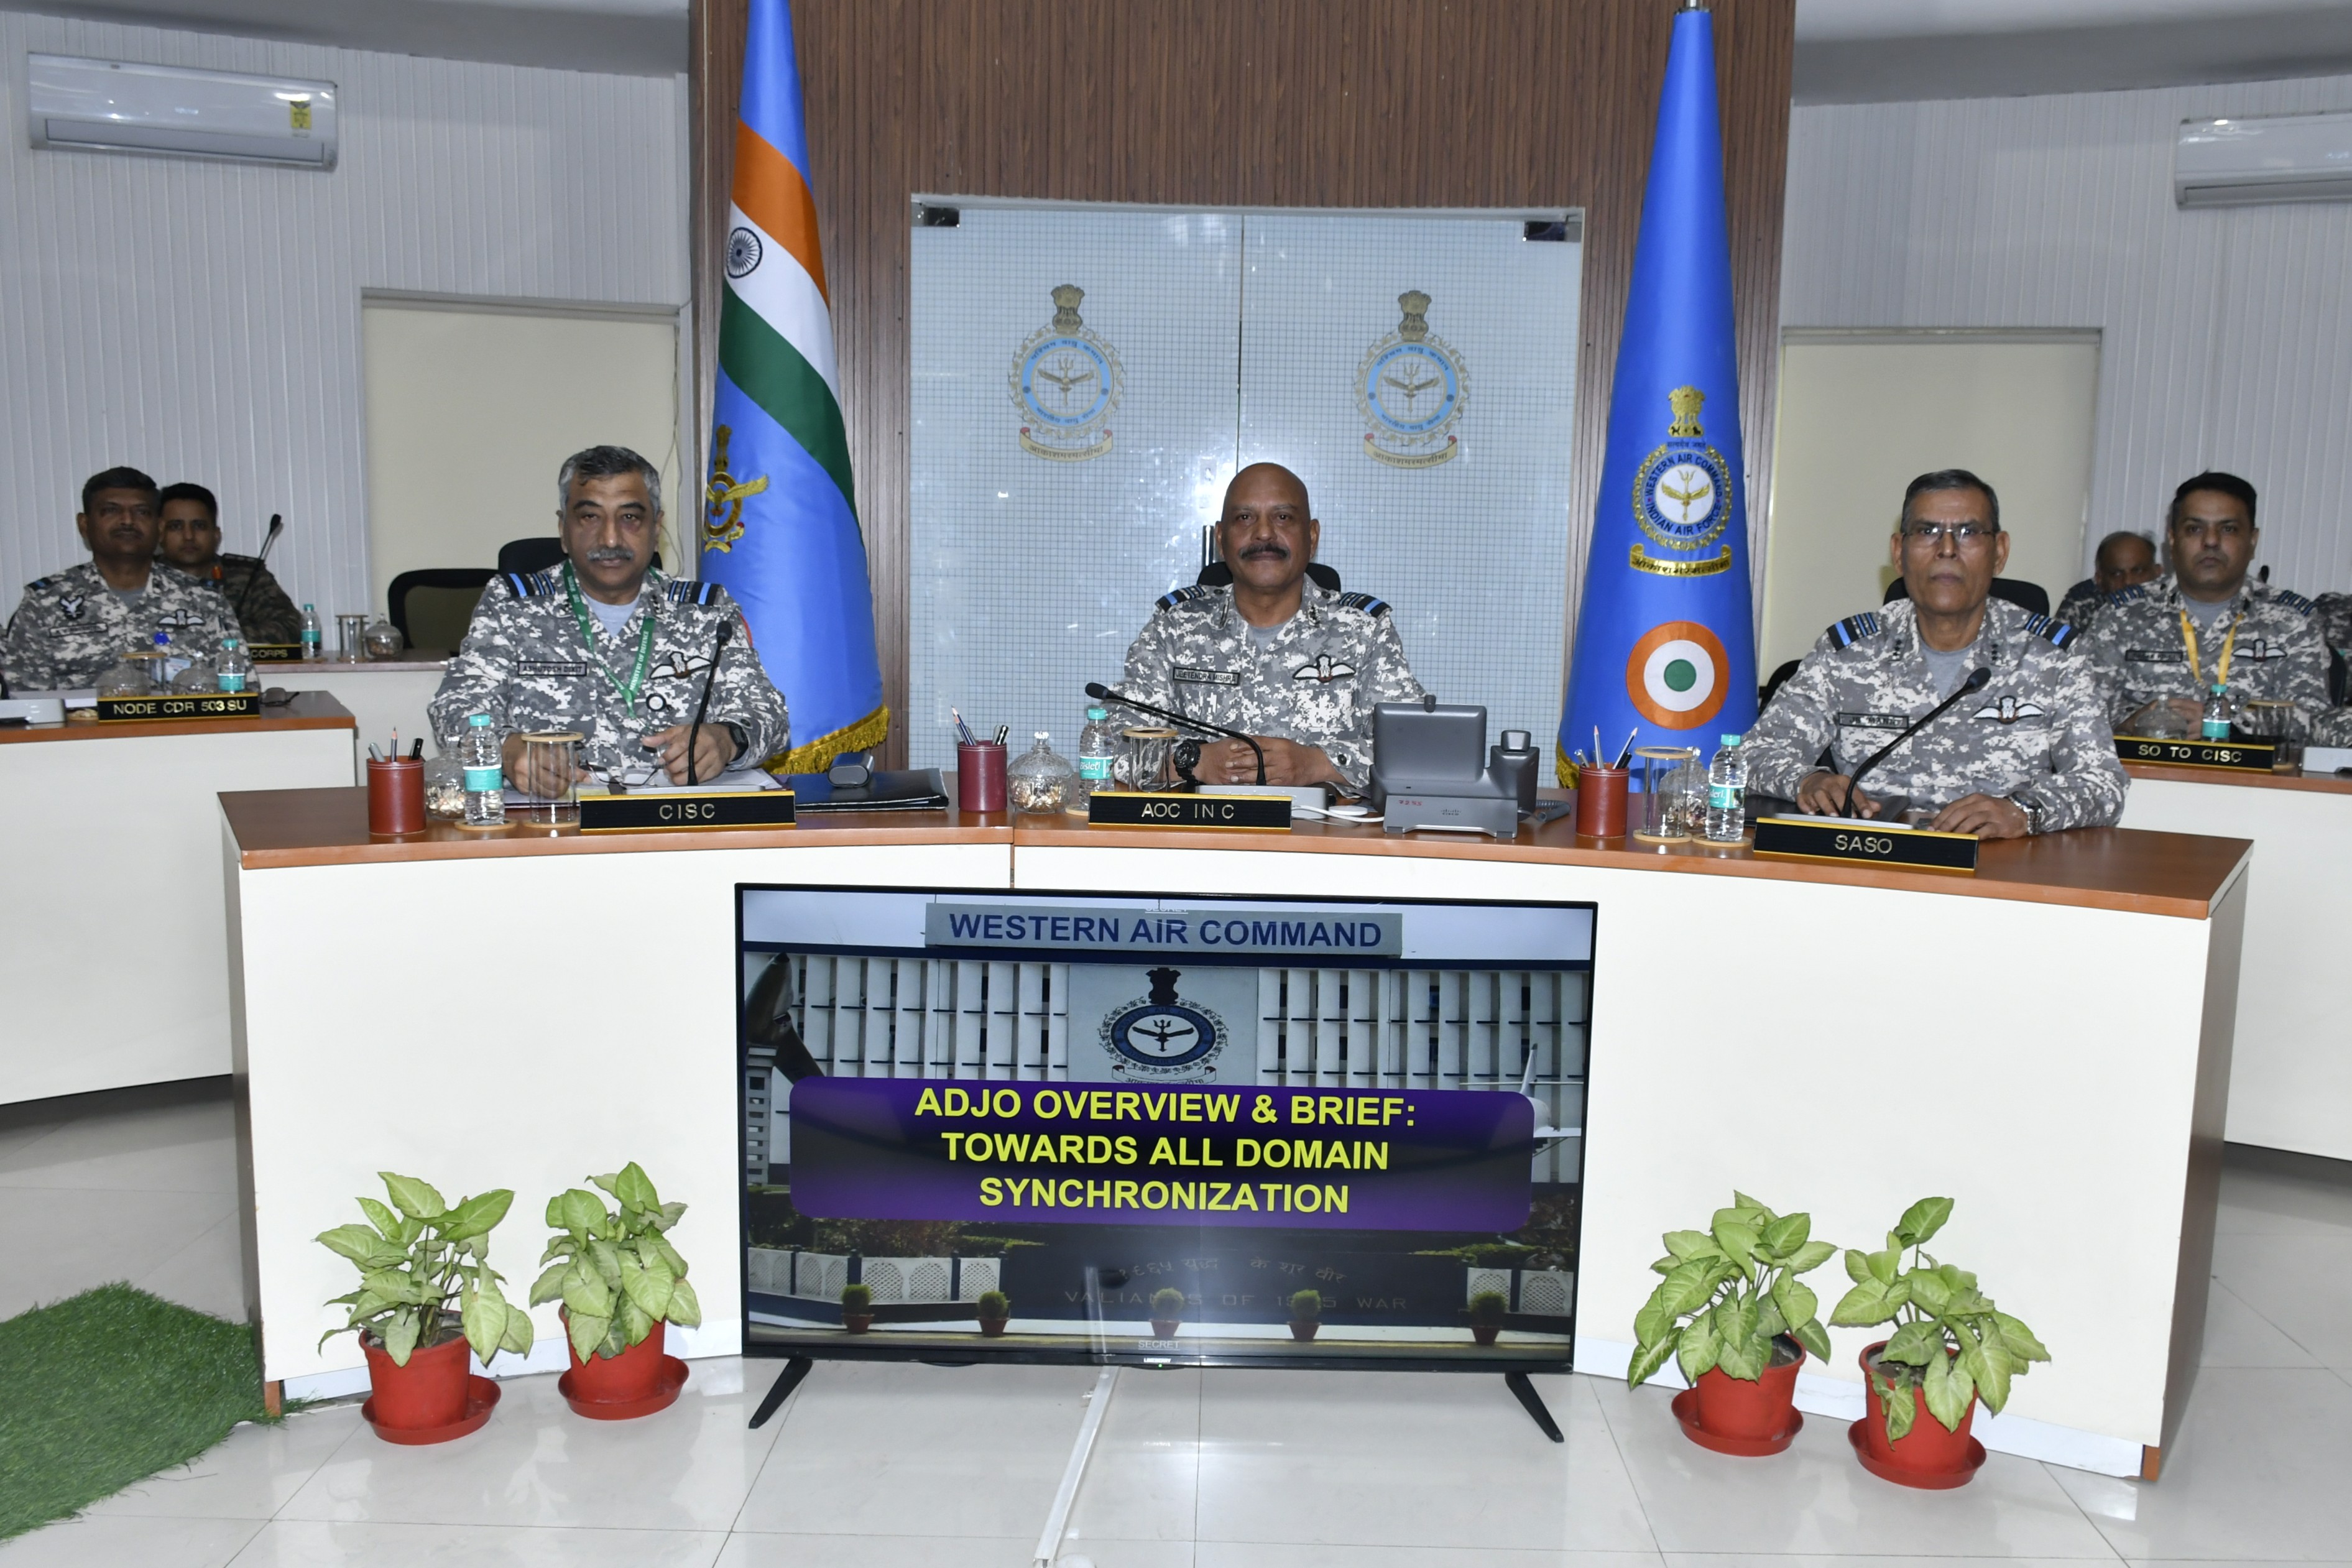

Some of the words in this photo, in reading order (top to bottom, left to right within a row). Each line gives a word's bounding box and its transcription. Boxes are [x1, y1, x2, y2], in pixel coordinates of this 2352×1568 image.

[1645, 456, 1675, 496] WESTERN
[1677, 454, 1692, 463] AIR
[1695, 456, 1723, 497] COMMAND
[1646, 503, 1673, 532] INDIAN
[1674, 526, 1694, 535] AIR
[1697, 504, 1722, 533] FORCE
[640, 630, 649, 654] DEFENCE
[251, 649, 288, 658] CORPS
[638, 653, 645, 662] OF
[629, 662, 642, 691] MINISTRY
[1176, 670, 1212, 680] JEETENDRA
[1213, 673, 1236, 683] MISHRA
[113, 703, 157, 714] NODE
[163, 702, 195, 713] CDR
[201, 701, 225, 712] 503
[227, 699, 247, 711] SU
[2138, 744, 2161, 757] SO
[2170, 747, 2192, 759] TO
[2202, 749, 2242, 763] CISC
[659, 803, 715, 820] CISC
[1141, 803, 1180, 818] AOC
[1194, 803, 1214, 818] IN
[1221, 804, 1234, 819] C
[1835, 834, 1893, 854] SASO
[949, 913, 1119, 943] WESTERN
[1129, 918, 1188, 944] AIR
[1199, 920, 1381, 947] COMMAND
[915, 1088, 1021, 1118] ADJO
[1033, 1090, 1240, 1122] OVERVIEW
[1252, 1094, 1278, 1123] &
[1291, 1095, 1415, 1127] BRIEF:
[941, 1132, 1138, 1164] TOWARDS
[1149, 1137, 1223, 1166] ALL
[1236, 1138, 1388, 1169] DOMAIN
[979, 1177, 1349, 1213] SYNCHRONIZATION
[1315, 1266, 1348, 1283] वीर
[1065, 1291, 1202, 1305] VALIAS
[1222, 1294, 1255, 1306] OF
[1277, 1296, 1337, 1308] 195
[1357, 1297, 1406, 1309] WAR
[1138, 1340, 1179, 1349] SECRET
